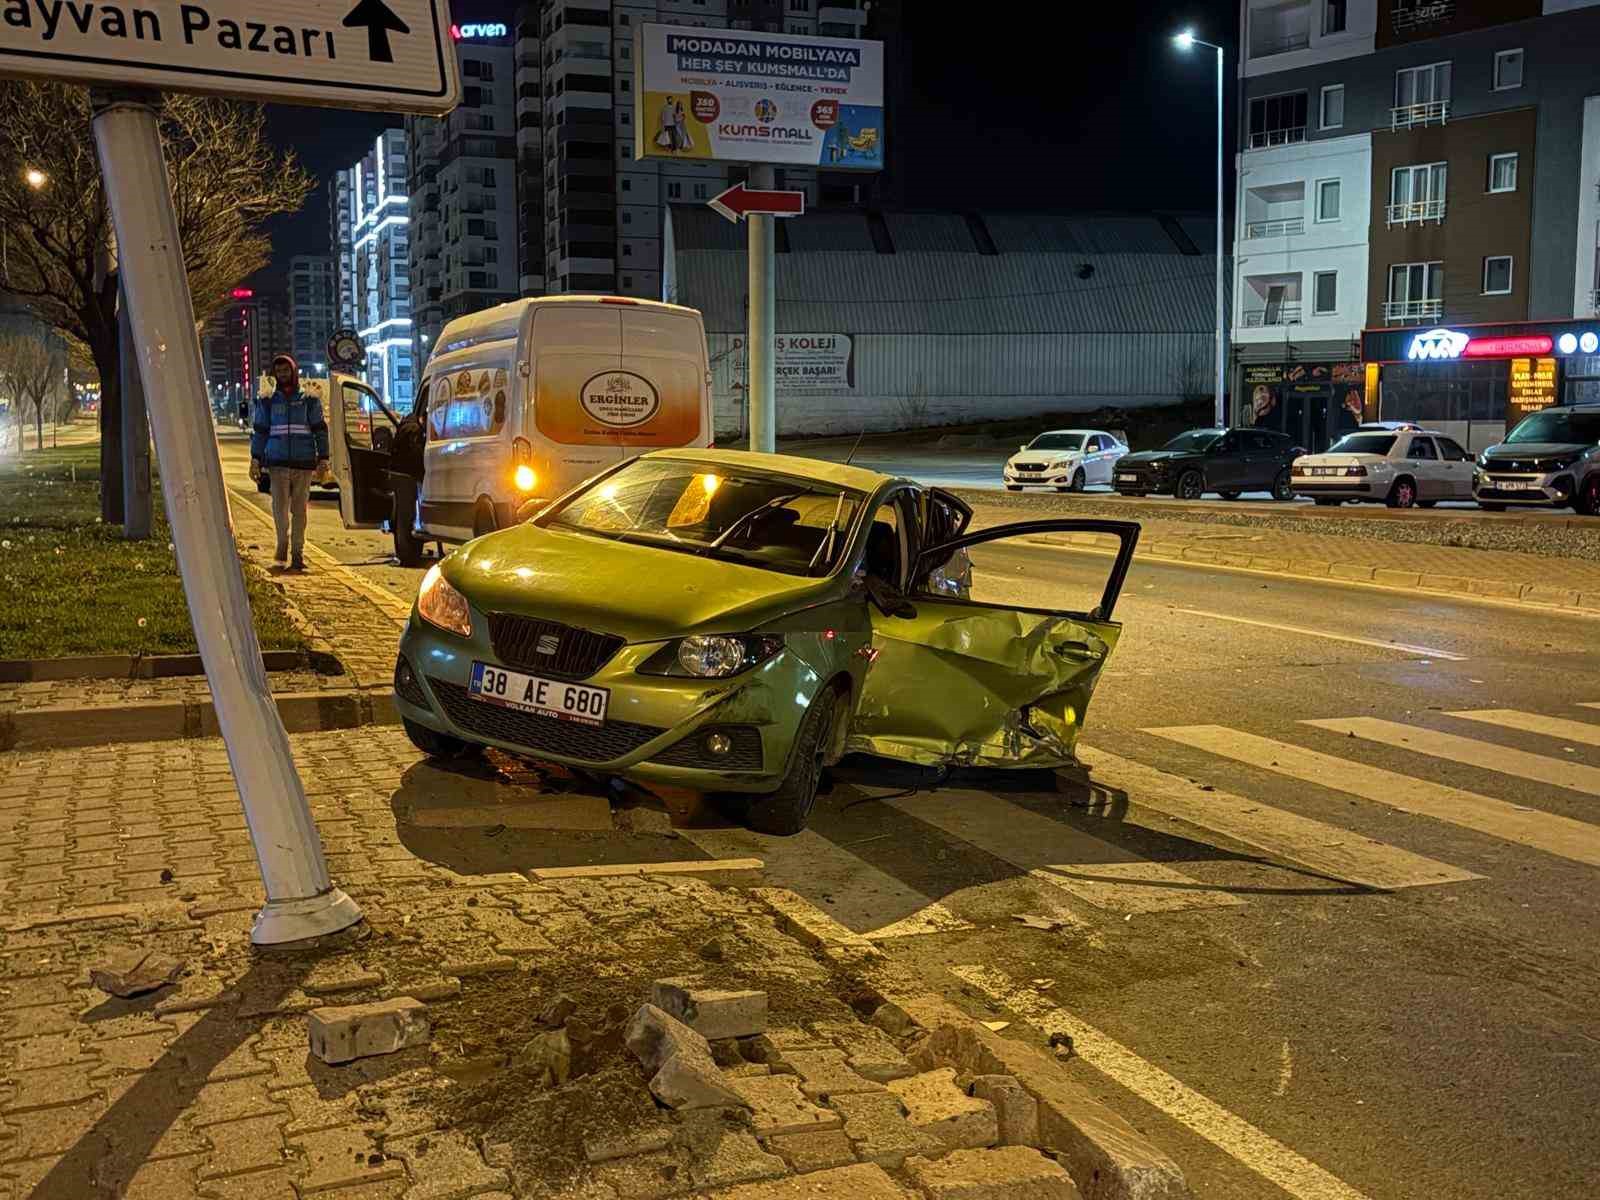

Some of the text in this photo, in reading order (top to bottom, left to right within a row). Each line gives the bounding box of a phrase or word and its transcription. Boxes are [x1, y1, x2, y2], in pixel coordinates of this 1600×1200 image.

[180, 5, 337, 60] Pazarı
[672, 38, 857, 65] MODADAN MOBİLYAYA
[681, 57, 848, 80] HER ŞEY KUMSMALL'DA
[790, 335, 836, 349] KOLEJİ
[776, 366, 836, 377] RÇEK BAŞARI
[590, 393, 649, 406] ERGİNLER
[483, 669, 508, 695] 38
[523, 678, 550, 705] AE
[563, 687, 603, 716] 680
